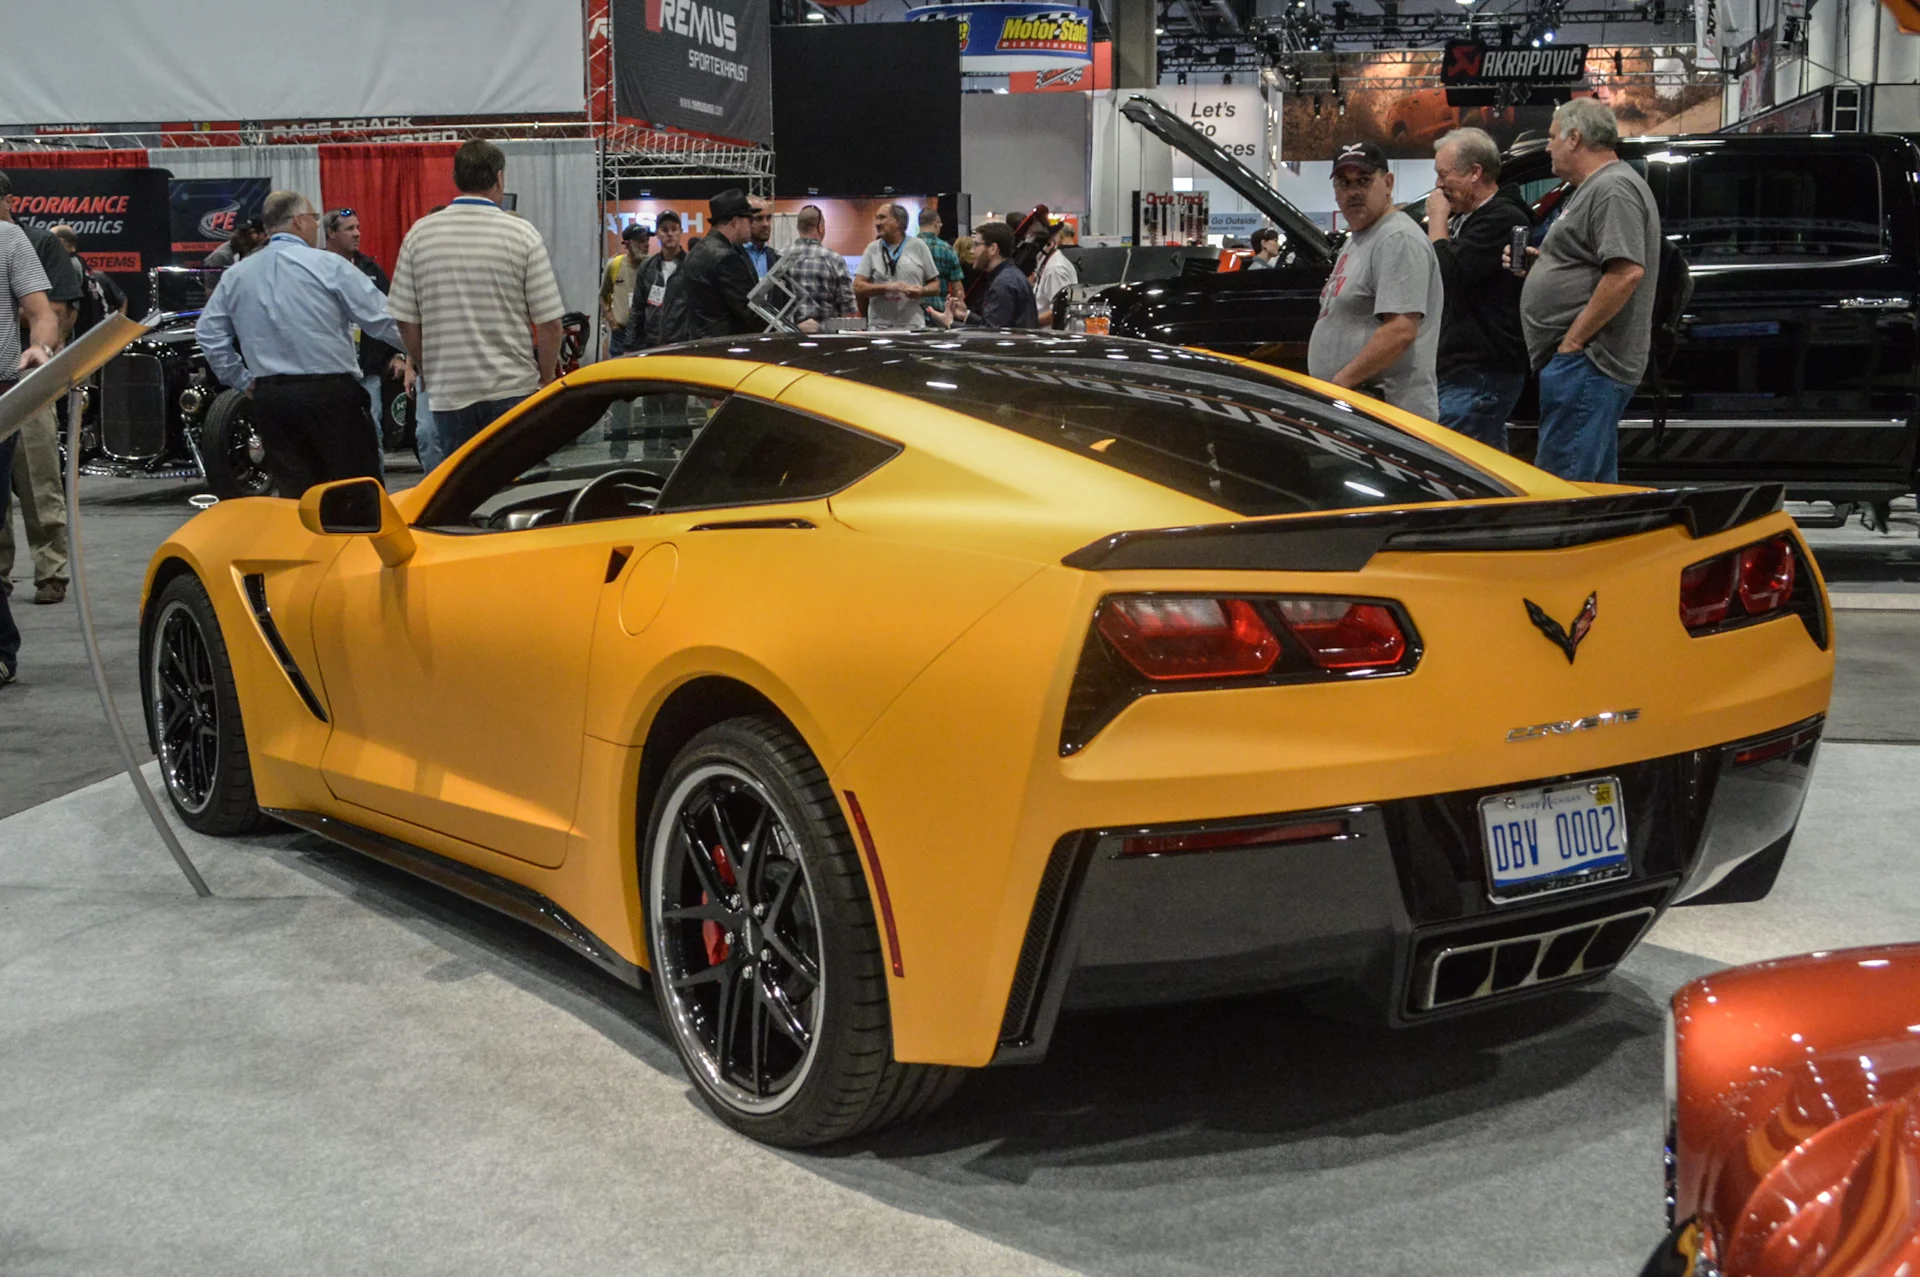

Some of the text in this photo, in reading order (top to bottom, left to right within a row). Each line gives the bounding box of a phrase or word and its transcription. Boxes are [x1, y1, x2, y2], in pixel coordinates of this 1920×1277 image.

[659, 0, 737, 52] REMUS
[1002, 18, 1088, 43] Motor State
[688, 49, 748, 83] SPORTEXHAUST
[1191, 102, 1236, 118] Let's
[272, 116, 414, 138] RACE TRACK
[1191, 121, 1217, 137] Go
[1221, 143, 1256, 157] ces
[11, 195, 130, 214] RFORMANCE
[210, 211, 238, 231] PE
[86, 256, 136, 268] YSTEMS
[1491, 805, 1619, 873] DBV 0002
